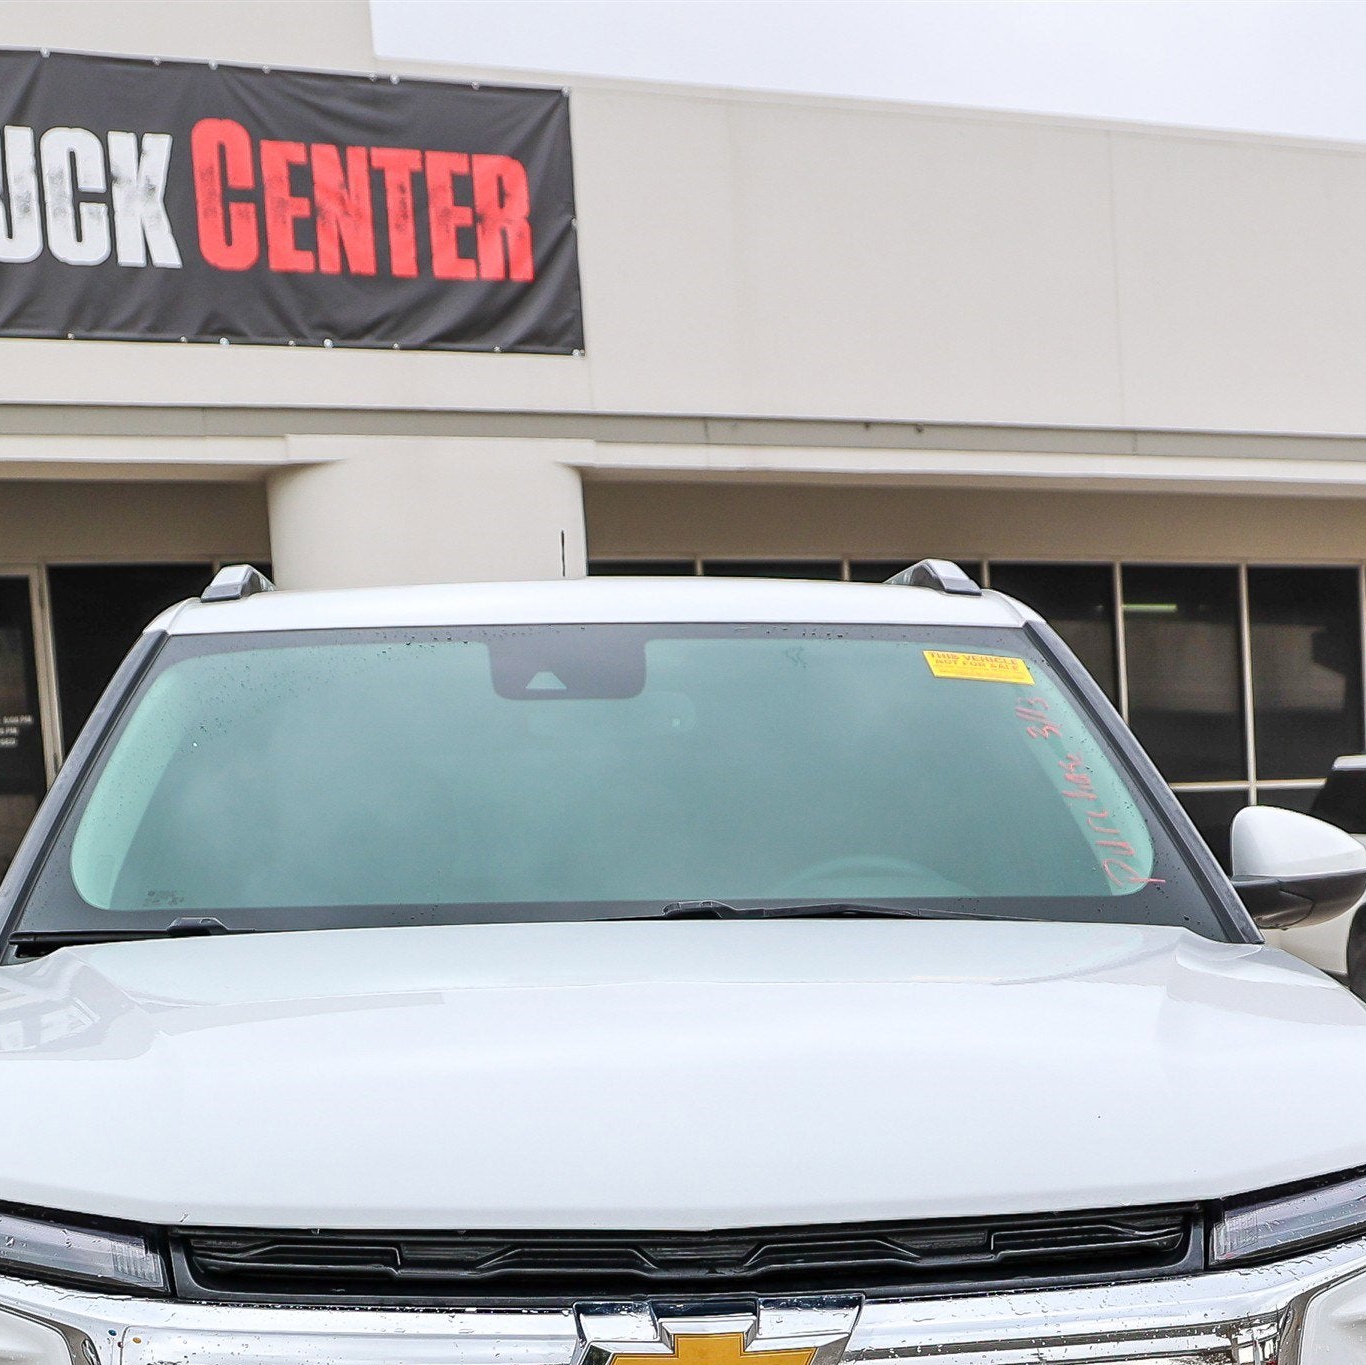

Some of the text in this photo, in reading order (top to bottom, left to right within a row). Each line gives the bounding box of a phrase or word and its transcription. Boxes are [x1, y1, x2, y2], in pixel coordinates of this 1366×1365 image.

[930, 651, 1019, 665] THIS VEHICLE
[962, 660, 986, 668] FOR
[990, 663, 1020, 671] SALE
